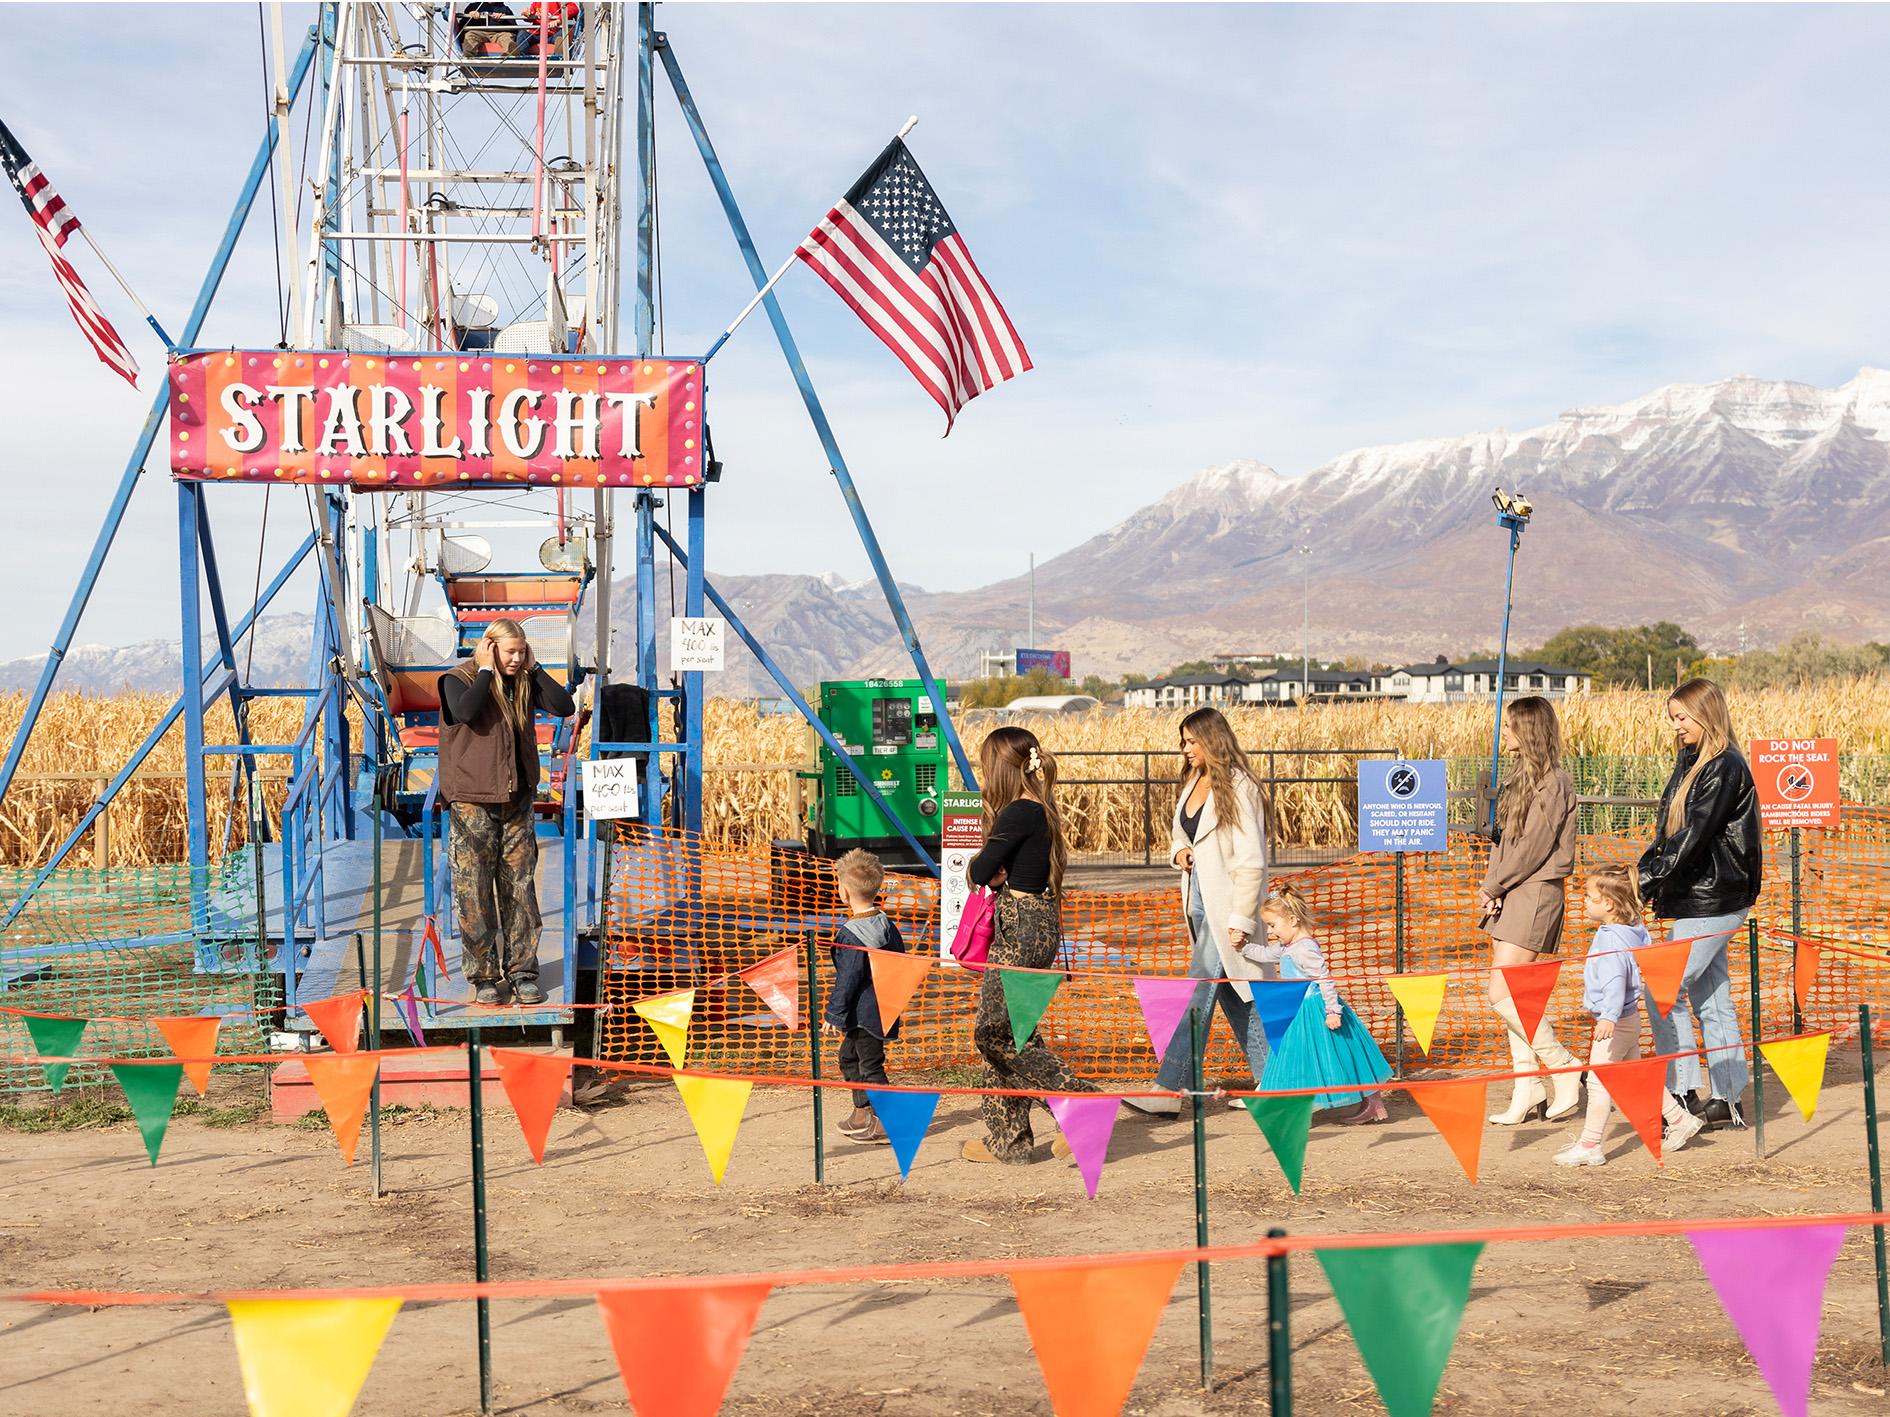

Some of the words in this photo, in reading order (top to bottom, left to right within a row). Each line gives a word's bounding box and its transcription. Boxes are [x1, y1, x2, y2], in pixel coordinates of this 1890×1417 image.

[219, 382, 658, 461] STARLIGHT
[681, 620, 716, 636] MAX
[1770, 740, 1789, 751] DO
[1792, 740, 1816, 751] NOT
[1759, 754, 1786, 763] ROCK
[1787, 753, 1804, 762] THE
[1806, 753, 1830, 762] SEAT.
[593, 764, 625, 779] MAX
[1370, 819, 1400, 827] SHOULD
[1401, 819, 1417, 827] NOT
[1418, 819, 1437, 827] RIDE.
[1410, 828, 1434, 836] PANIC
[1383, 838, 1392, 846] IN
